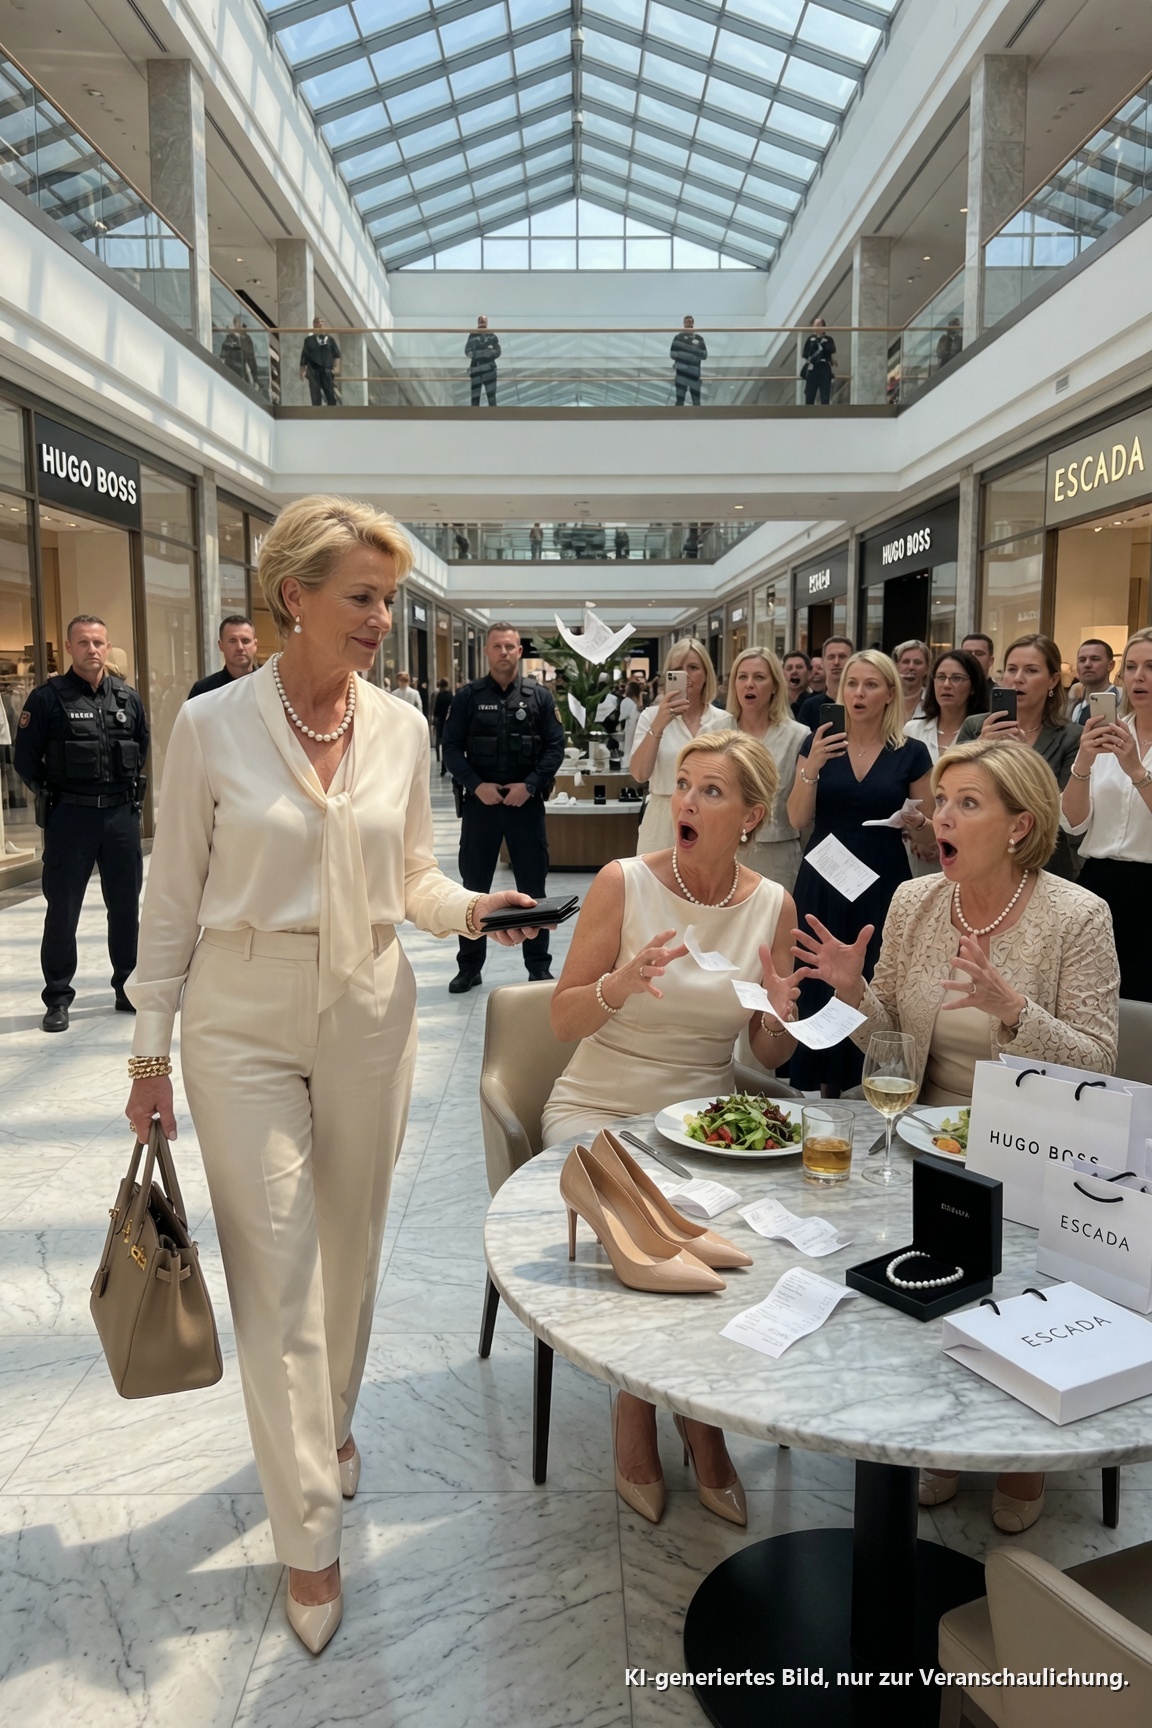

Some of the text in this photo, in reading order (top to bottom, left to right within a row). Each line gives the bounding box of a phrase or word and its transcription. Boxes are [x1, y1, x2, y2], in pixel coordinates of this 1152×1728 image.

[42, 443, 137, 505] HUGO BOSS
[1054, 435, 1145, 502] ESCADA
[882, 527, 931, 566] HUGO BOSS
[989, 1130, 1040, 1155] HUGO
[1060, 1214, 1130, 1252] ESCADA
[1021, 1315, 1112, 1349] ESCADA
